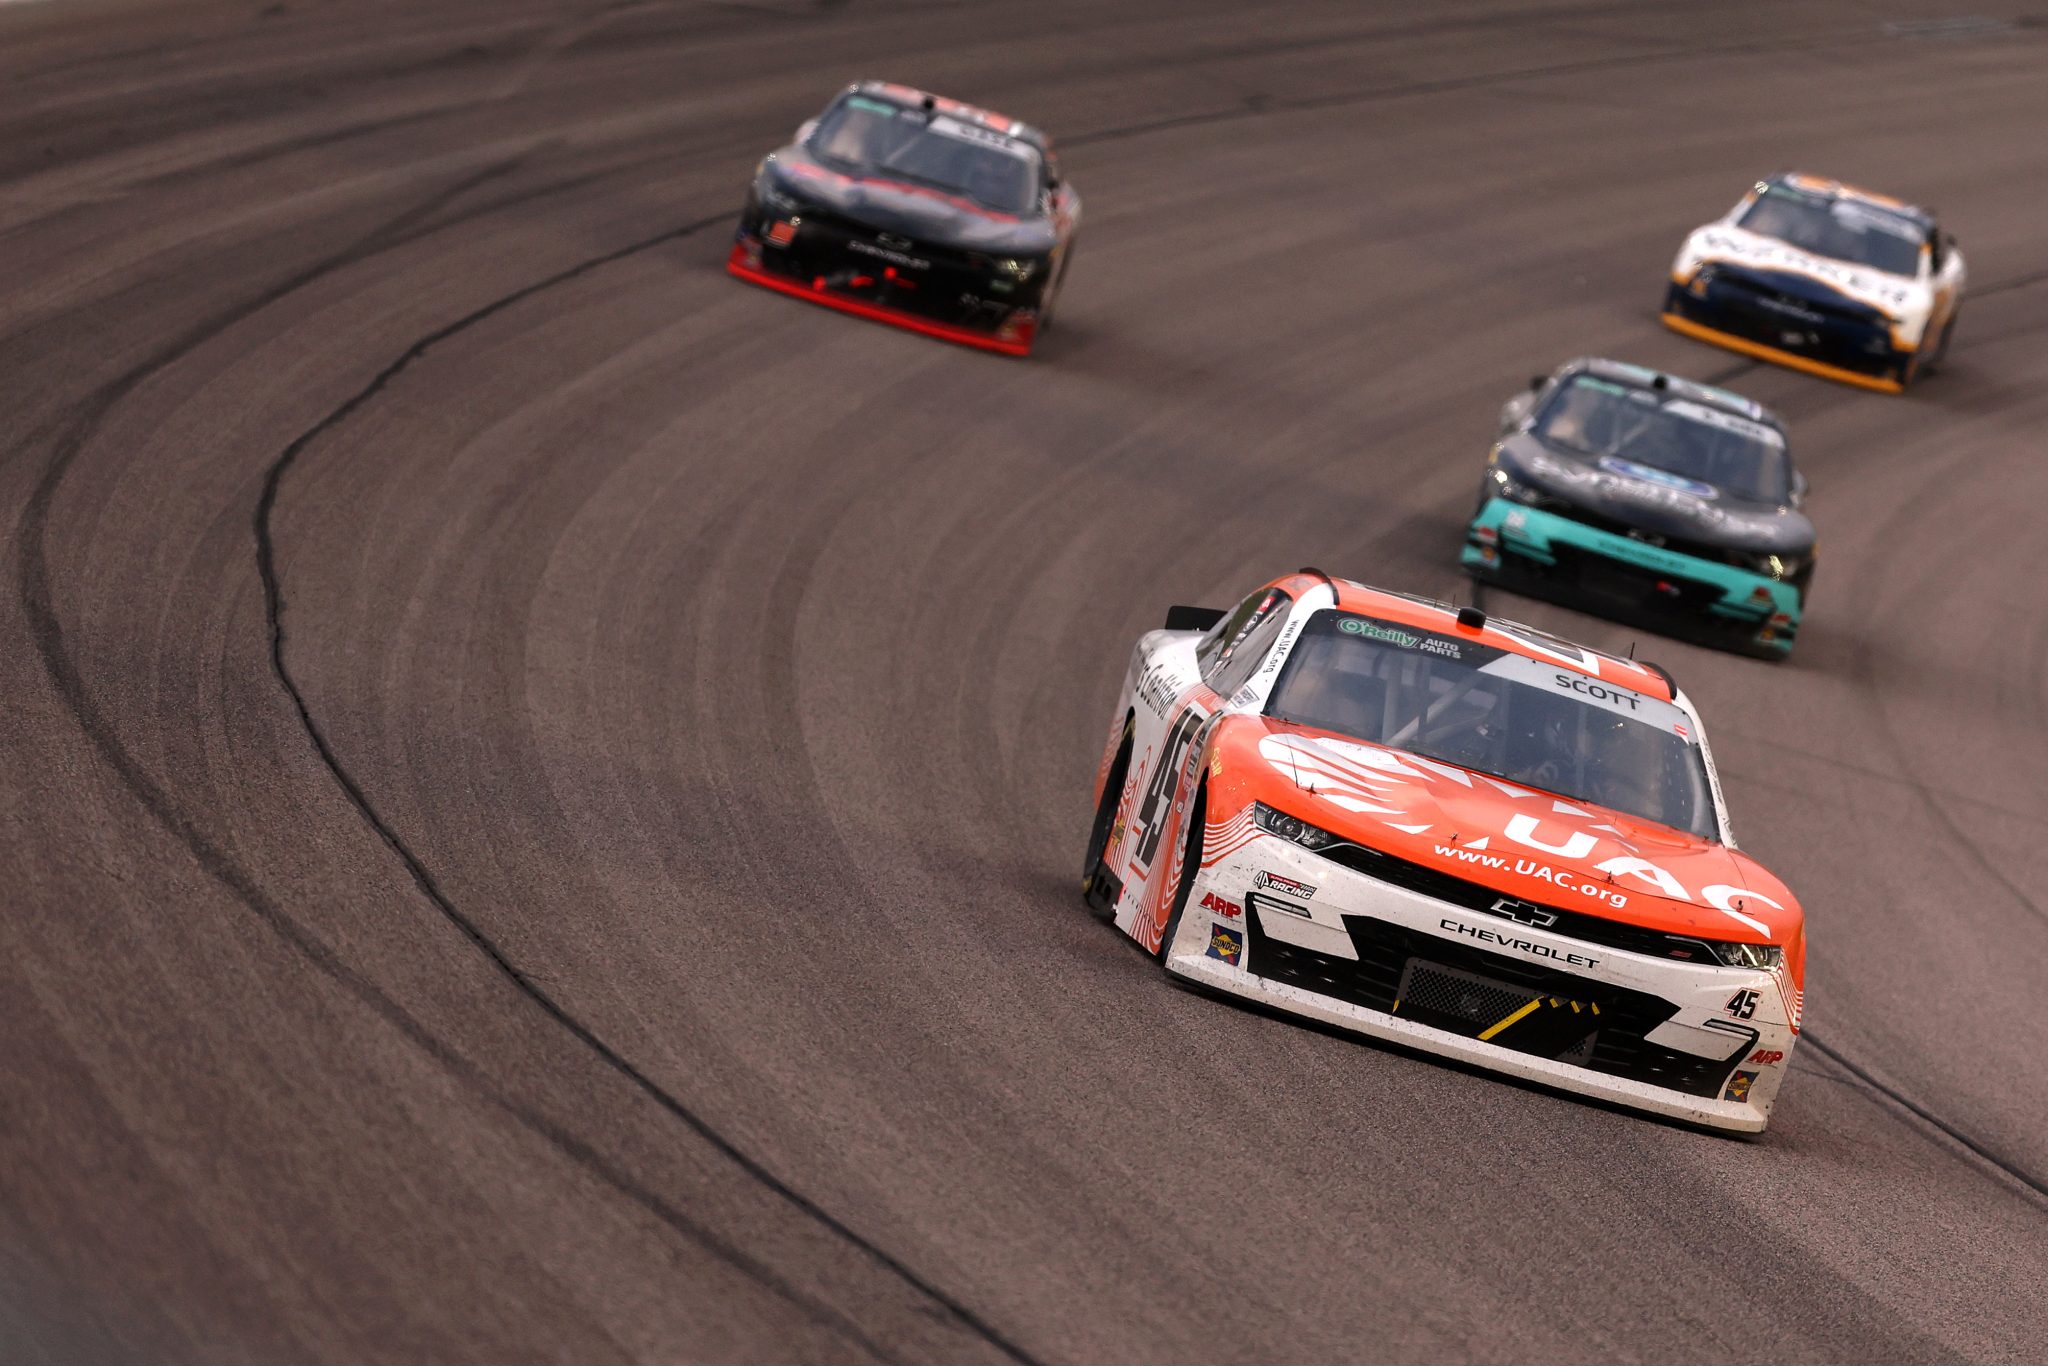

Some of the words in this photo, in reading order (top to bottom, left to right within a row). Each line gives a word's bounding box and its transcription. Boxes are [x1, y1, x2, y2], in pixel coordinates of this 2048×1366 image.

[1337, 618, 1420, 648] O'Reilly
[1425, 638, 1459, 651] AUTO
[1420, 643, 1462, 659] PARTS
[1555, 673, 1642, 711] SCOTT
[1269, 880, 1313, 899] RACING
[1434, 844, 1628, 909] www.UAC.org
[1503, 813, 1784, 939] UAC
[1200, 892, 1242, 919] ARP
[1211, 936, 1241, 954] SUNOCO
[1439, 918, 1600, 969] CHEVROLET
[1727, 989, 1760, 1020] 45
